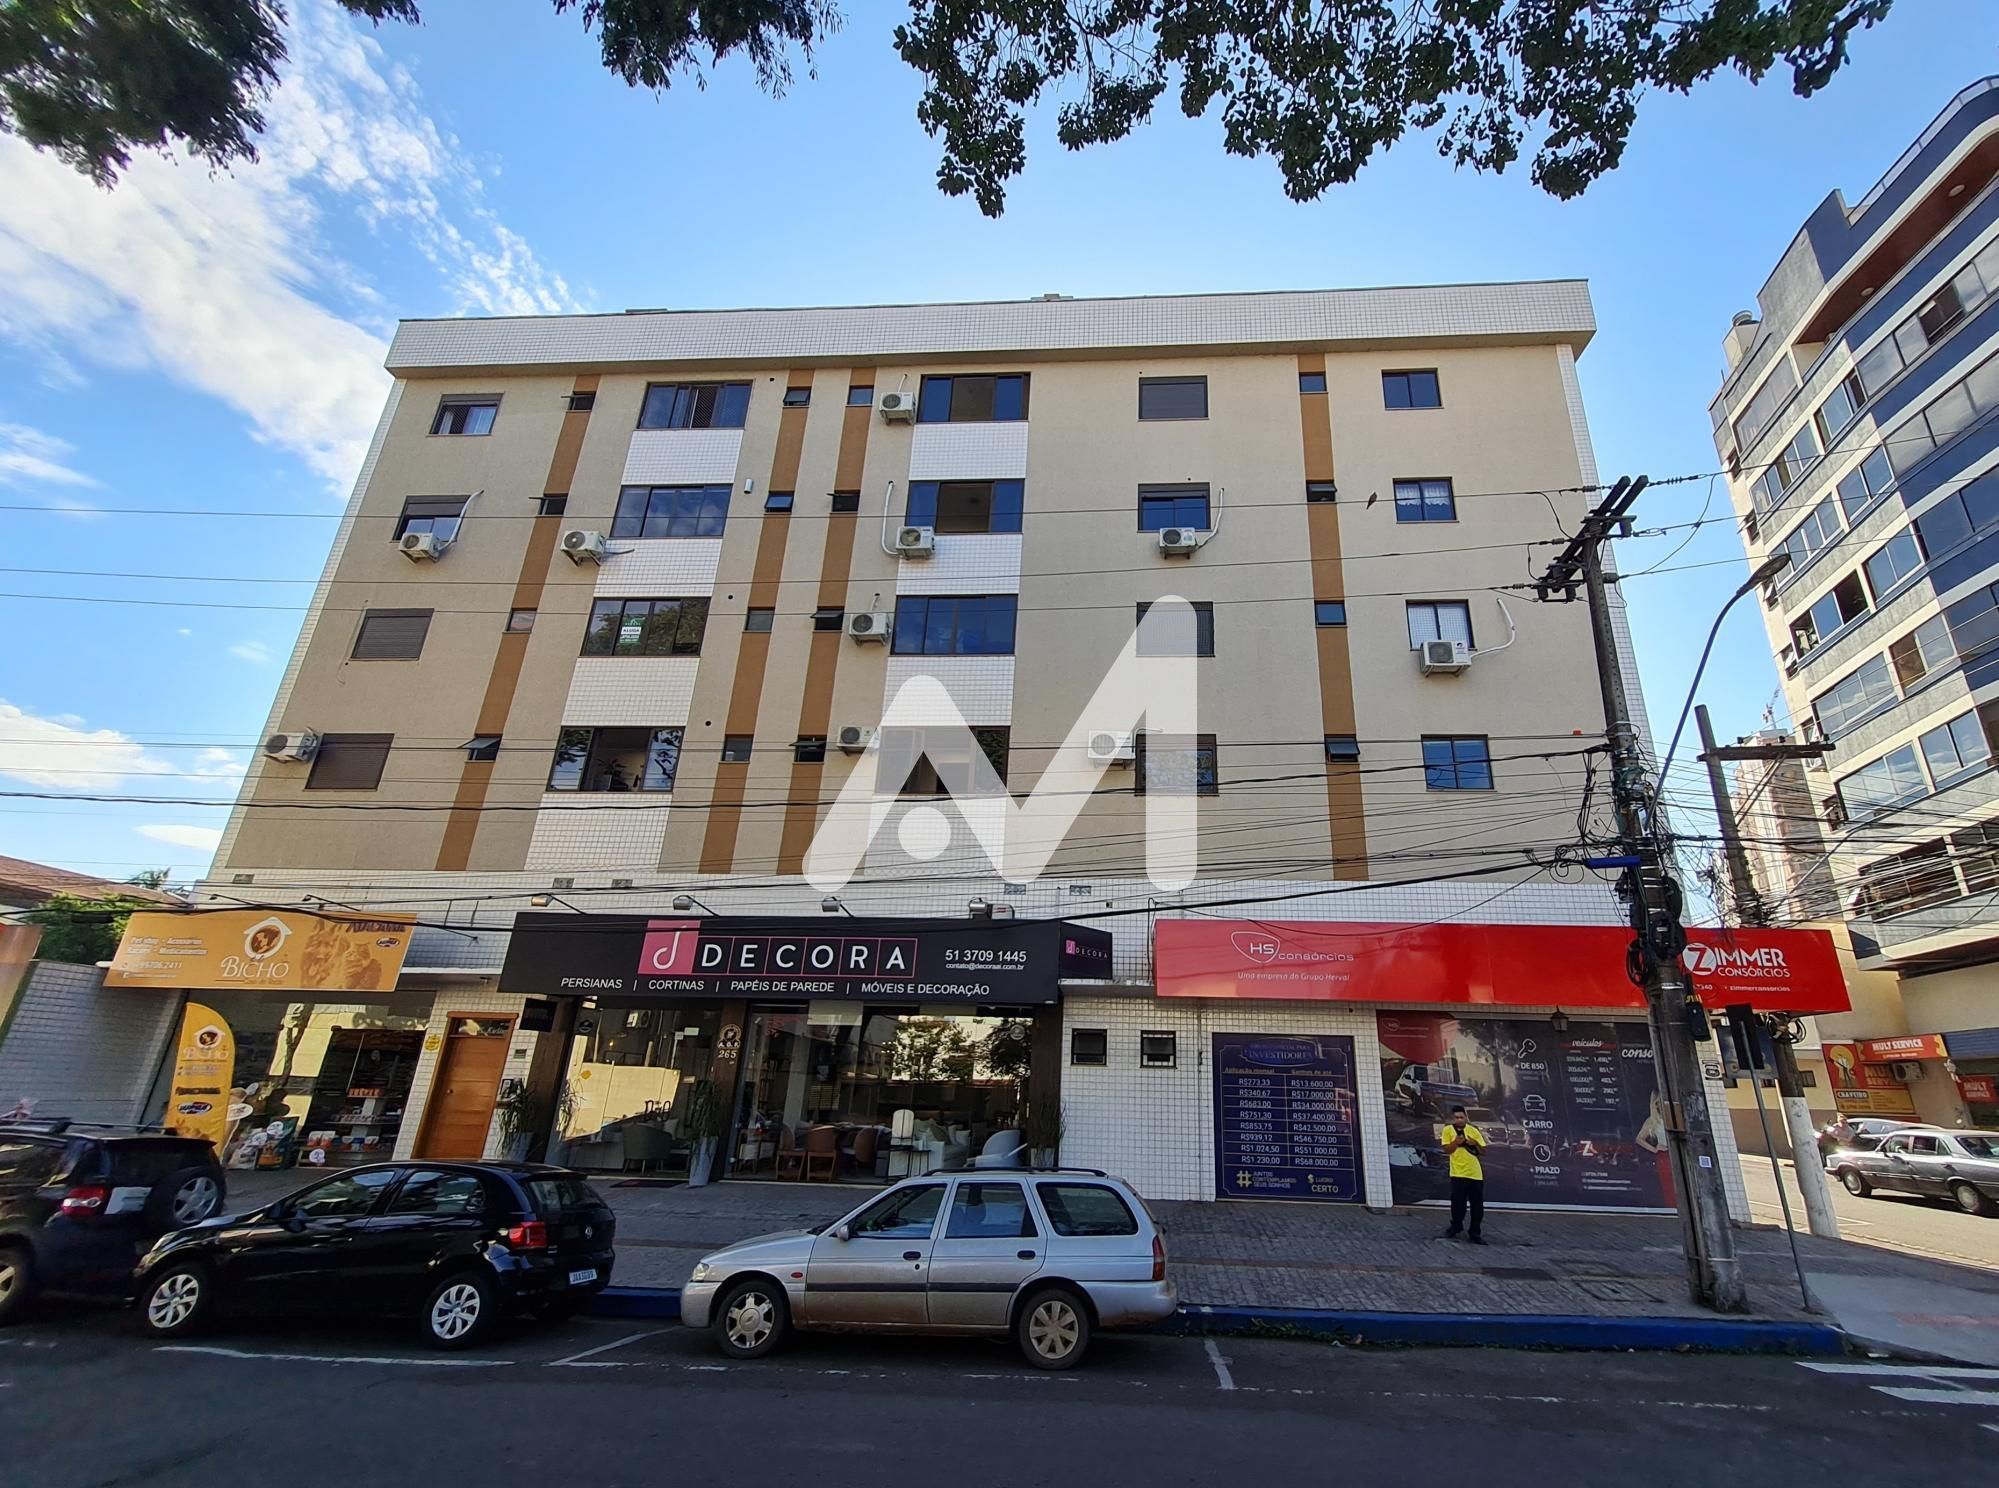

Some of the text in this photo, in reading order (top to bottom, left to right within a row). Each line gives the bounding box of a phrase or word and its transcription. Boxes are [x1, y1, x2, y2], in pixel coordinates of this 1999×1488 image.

[1250, 943, 1275, 954] HS
[701, 944, 905, 970] DECORA
[945, 949, 1027, 962] 51 3709 1445
[1278, 952, 1354, 961] consórcios
[1684, 945, 1787, 975] ZIMMER
[220, 956, 289, 978] BICHO
[1717, 966, 1791, 978] CONSÓRCIOS
[561, 977, 622, 989] PERSIANAS
[648, 980, 705, 991] CORTINAS
[731, 979, 835, 992] PAPÉIS DE PAREDE
[861, 981, 990, 997] MÓVEIS E DECORAÇÃO
[1892, 1038, 1923, 1049] SERVICE
[718, 1049, 737, 1059] 265
[1522, 1120, 1553, 1129] CARRO
[1535, 1166, 1560, 1174] PRAZO
[1311, 1184, 1339, 1193] CERTO
